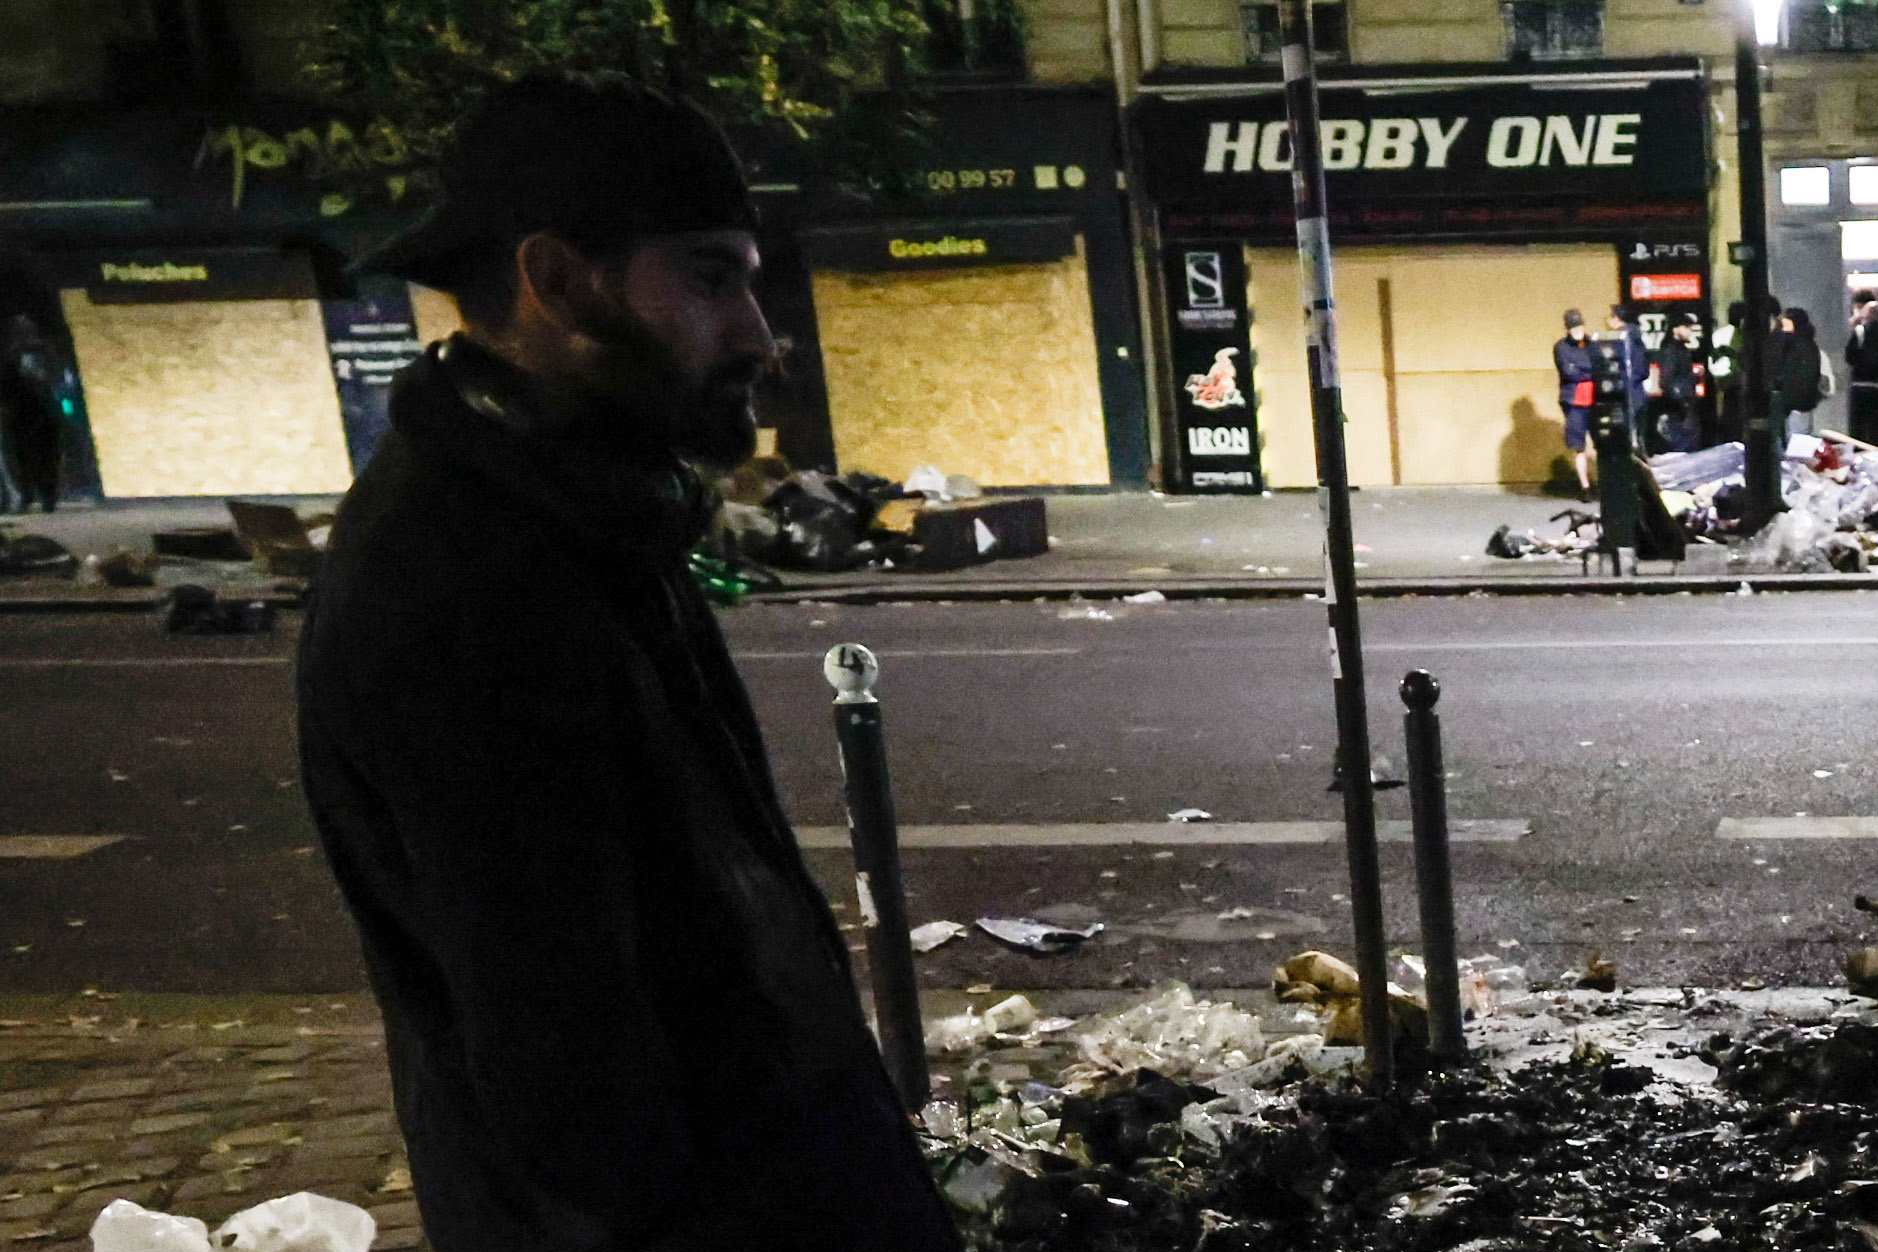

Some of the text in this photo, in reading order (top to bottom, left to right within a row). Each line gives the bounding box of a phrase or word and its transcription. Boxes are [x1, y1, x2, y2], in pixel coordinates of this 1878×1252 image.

[1203, 113, 1641, 173] HOBBY ONE
[888, 236, 987, 258] Goodies
[1188, 427, 1251, 454] IRON
